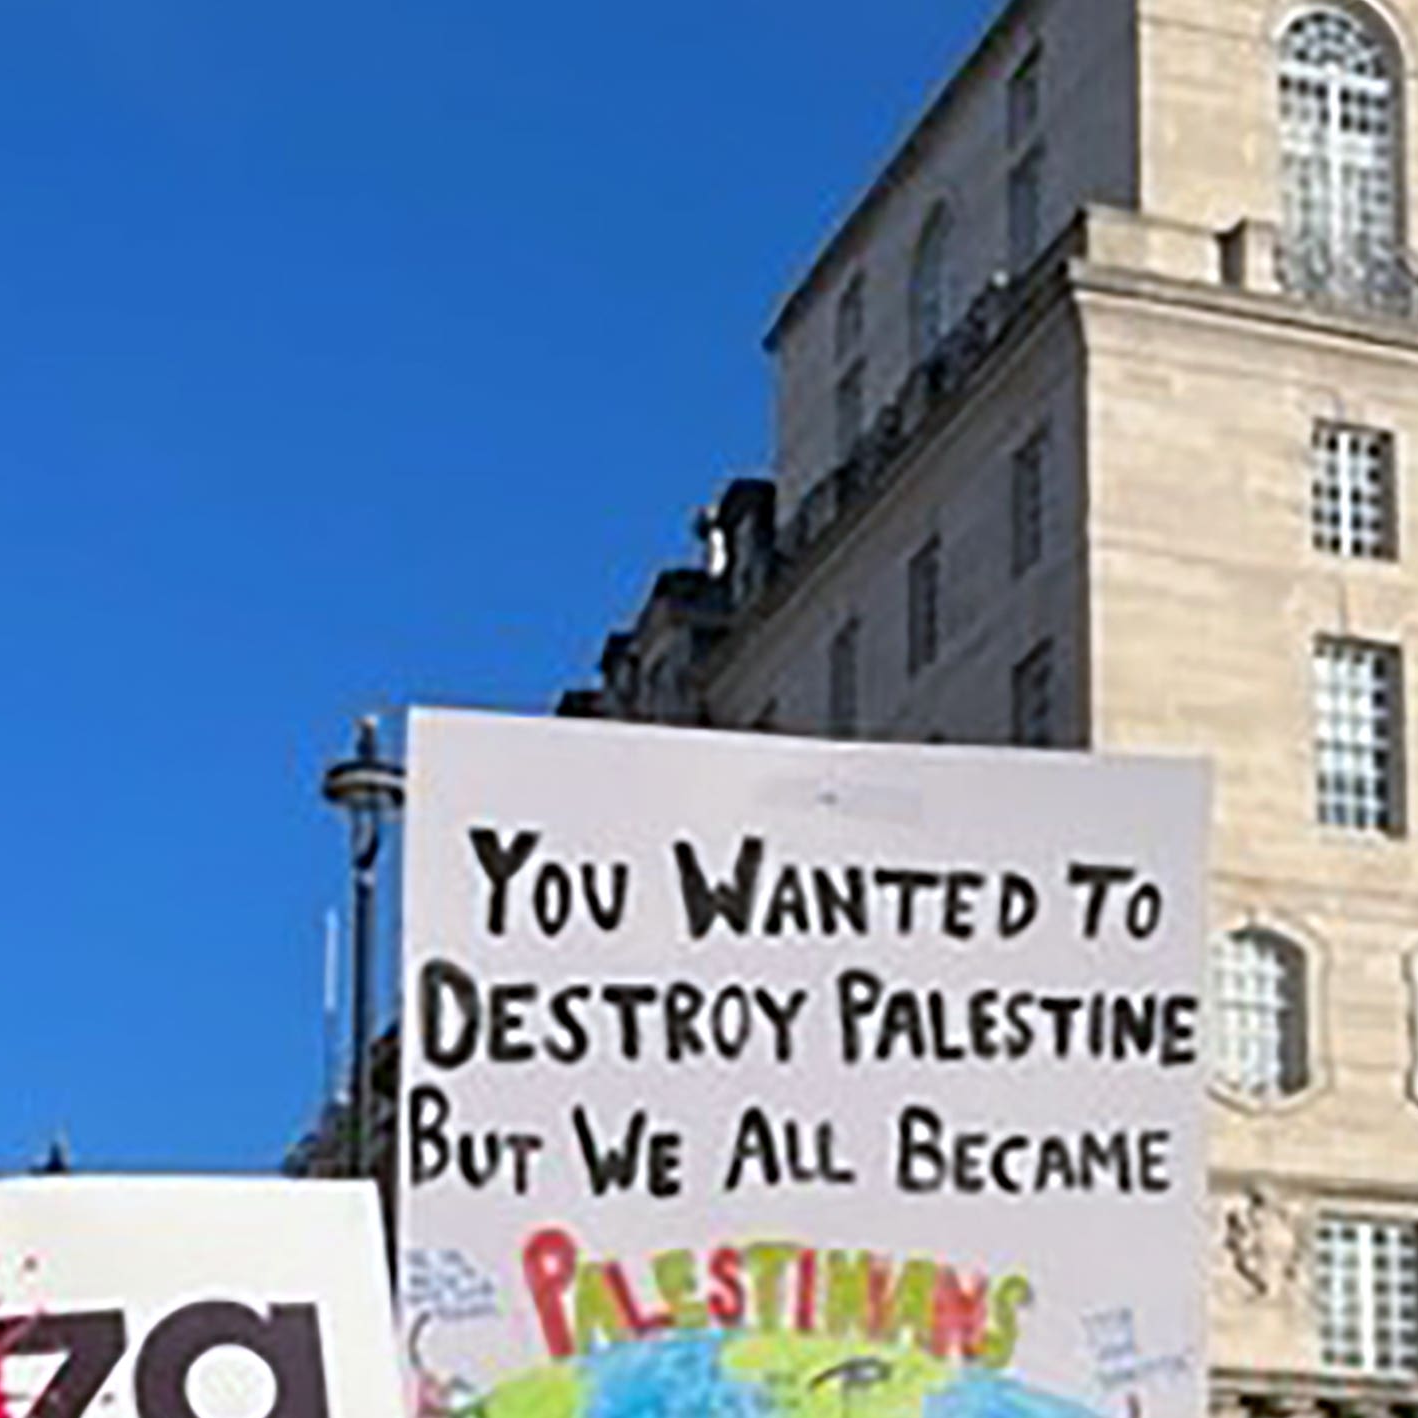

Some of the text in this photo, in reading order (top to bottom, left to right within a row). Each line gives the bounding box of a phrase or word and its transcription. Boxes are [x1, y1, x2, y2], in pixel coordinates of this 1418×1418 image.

[468, 826, 1163, 941] YOU WANTED TO
[420, 957, 1200, 1069] DESTROY PALESTINE
[408, 1083, 1173, 1198] BUT WE ALL BECAME
[522, 1226, 1032, 1366] PALESTINIANS
